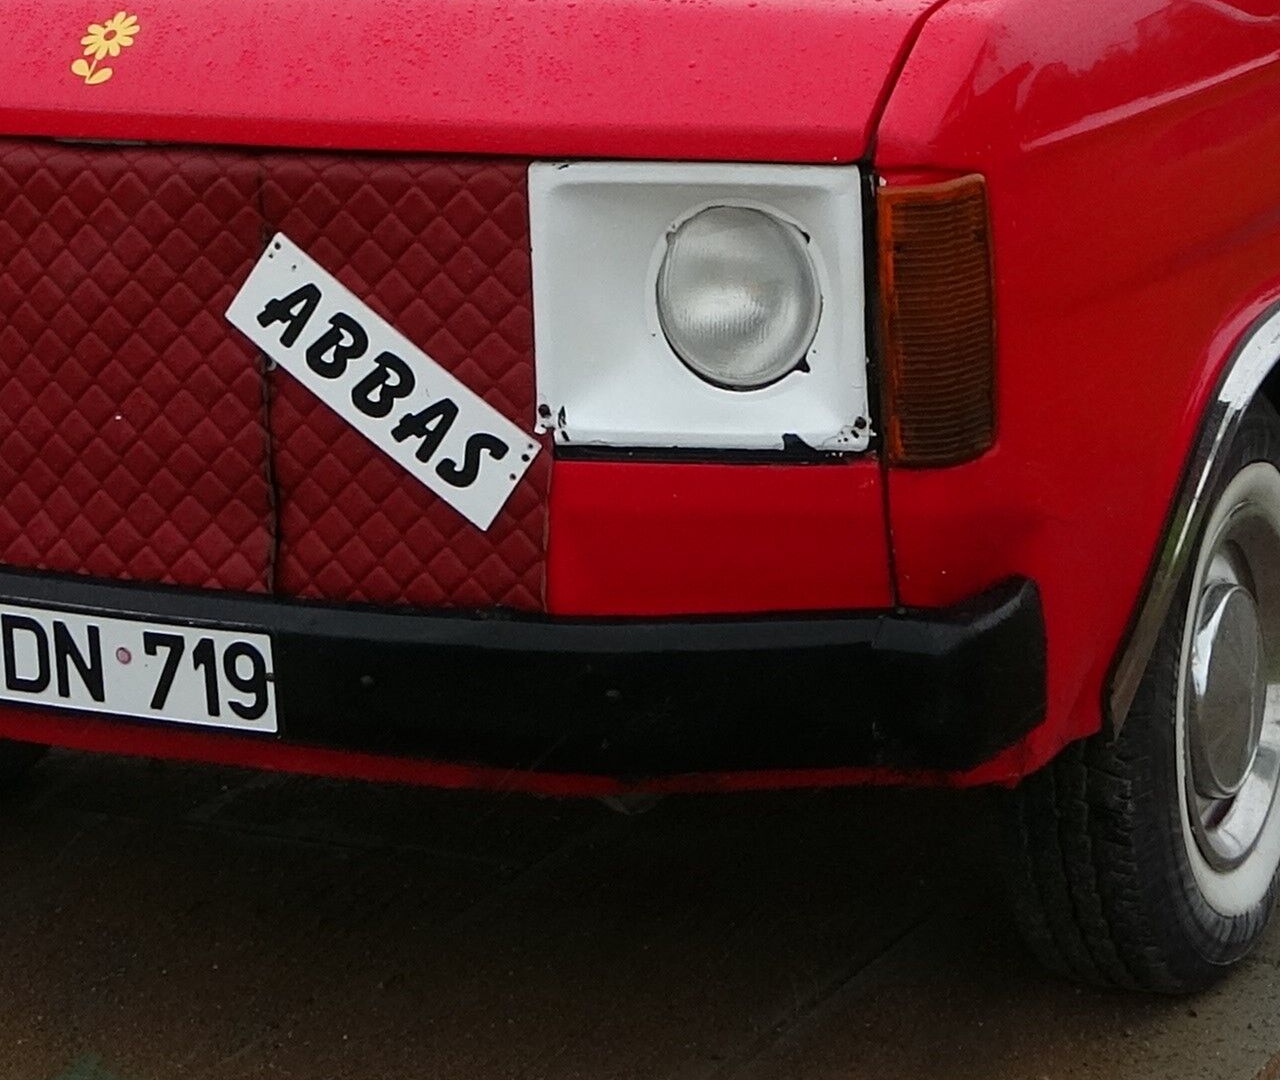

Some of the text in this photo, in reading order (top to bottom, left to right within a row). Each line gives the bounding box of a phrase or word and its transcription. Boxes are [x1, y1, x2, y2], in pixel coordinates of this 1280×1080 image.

[256, 283, 509, 488] ABBAS
[1, 613, 106, 702] DN
[142, 630, 269, 721] 719
